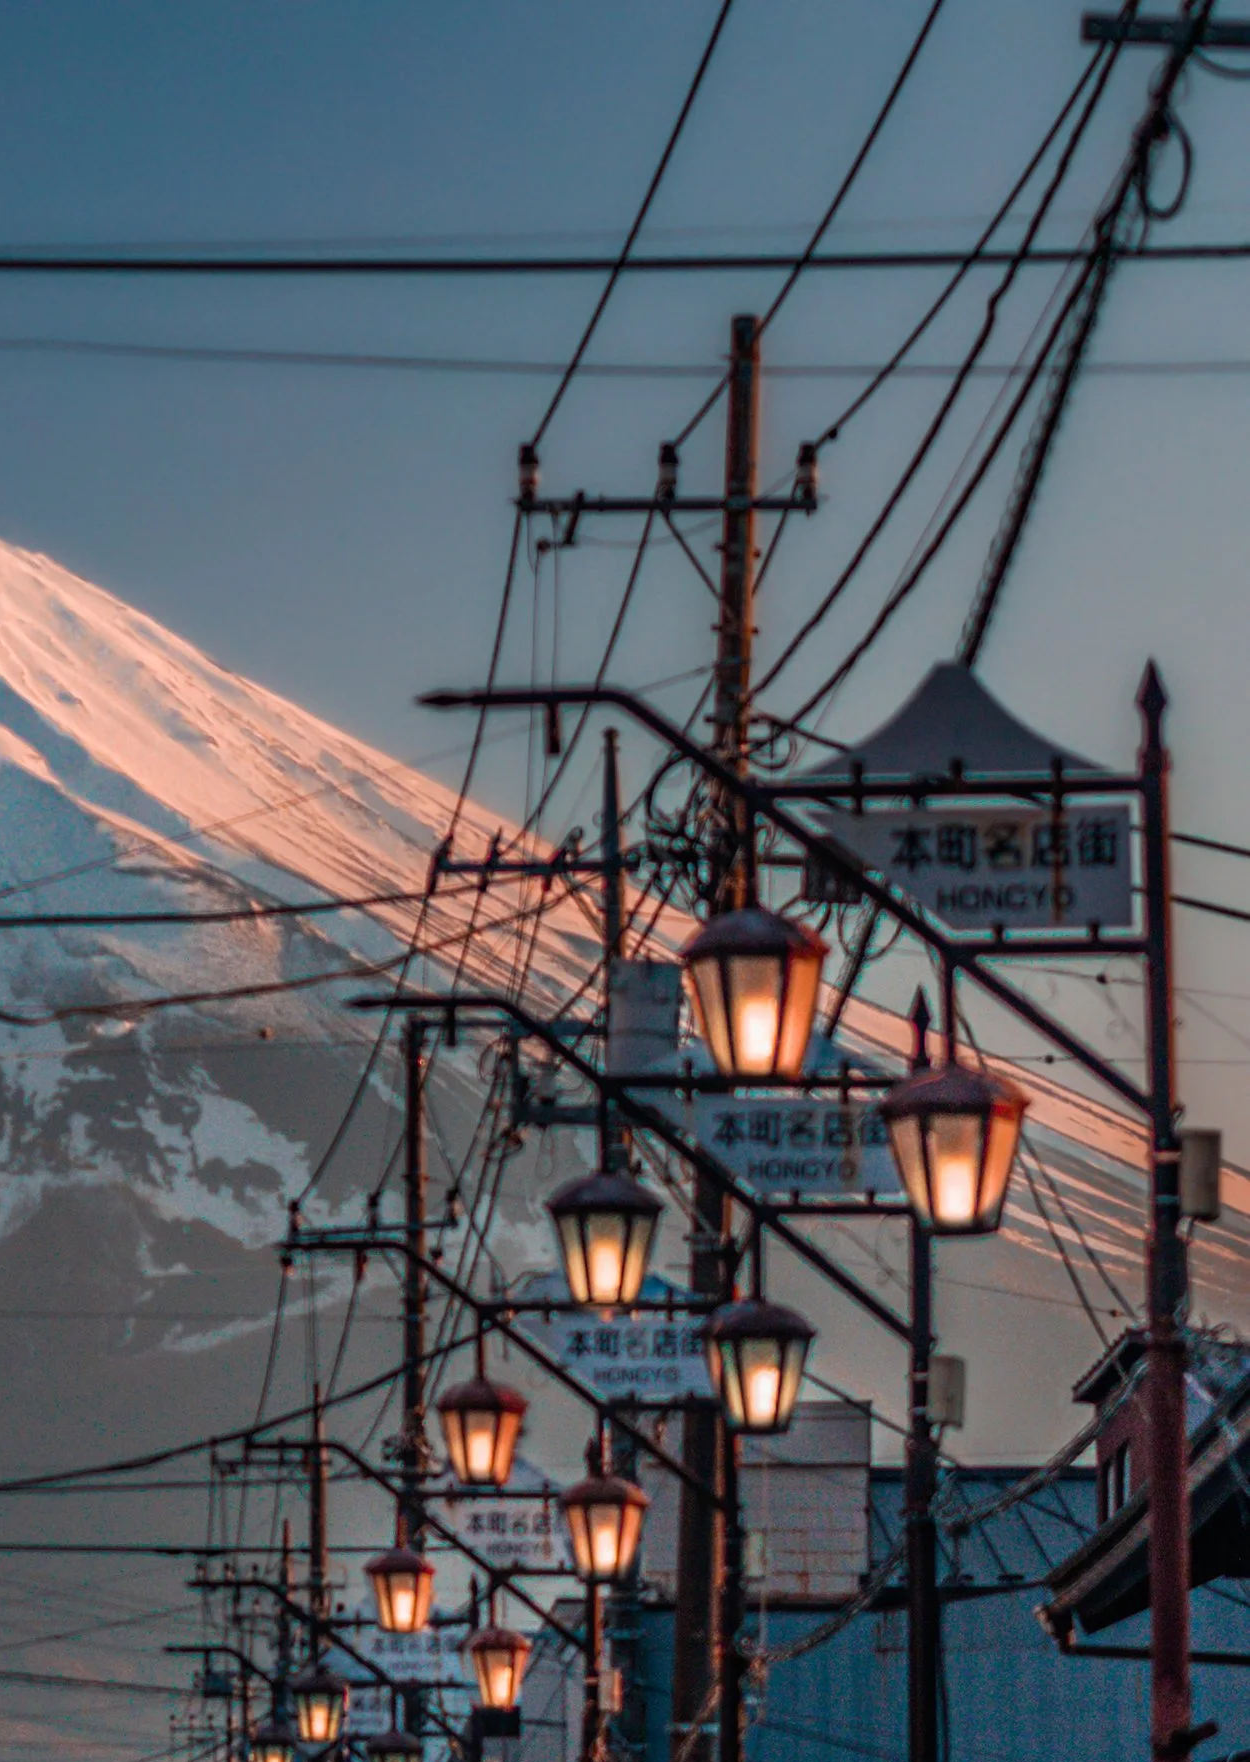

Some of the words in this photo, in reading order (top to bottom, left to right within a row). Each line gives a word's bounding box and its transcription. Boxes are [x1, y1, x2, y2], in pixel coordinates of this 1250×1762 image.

[890, 818, 1118, 871] 本町名店街
